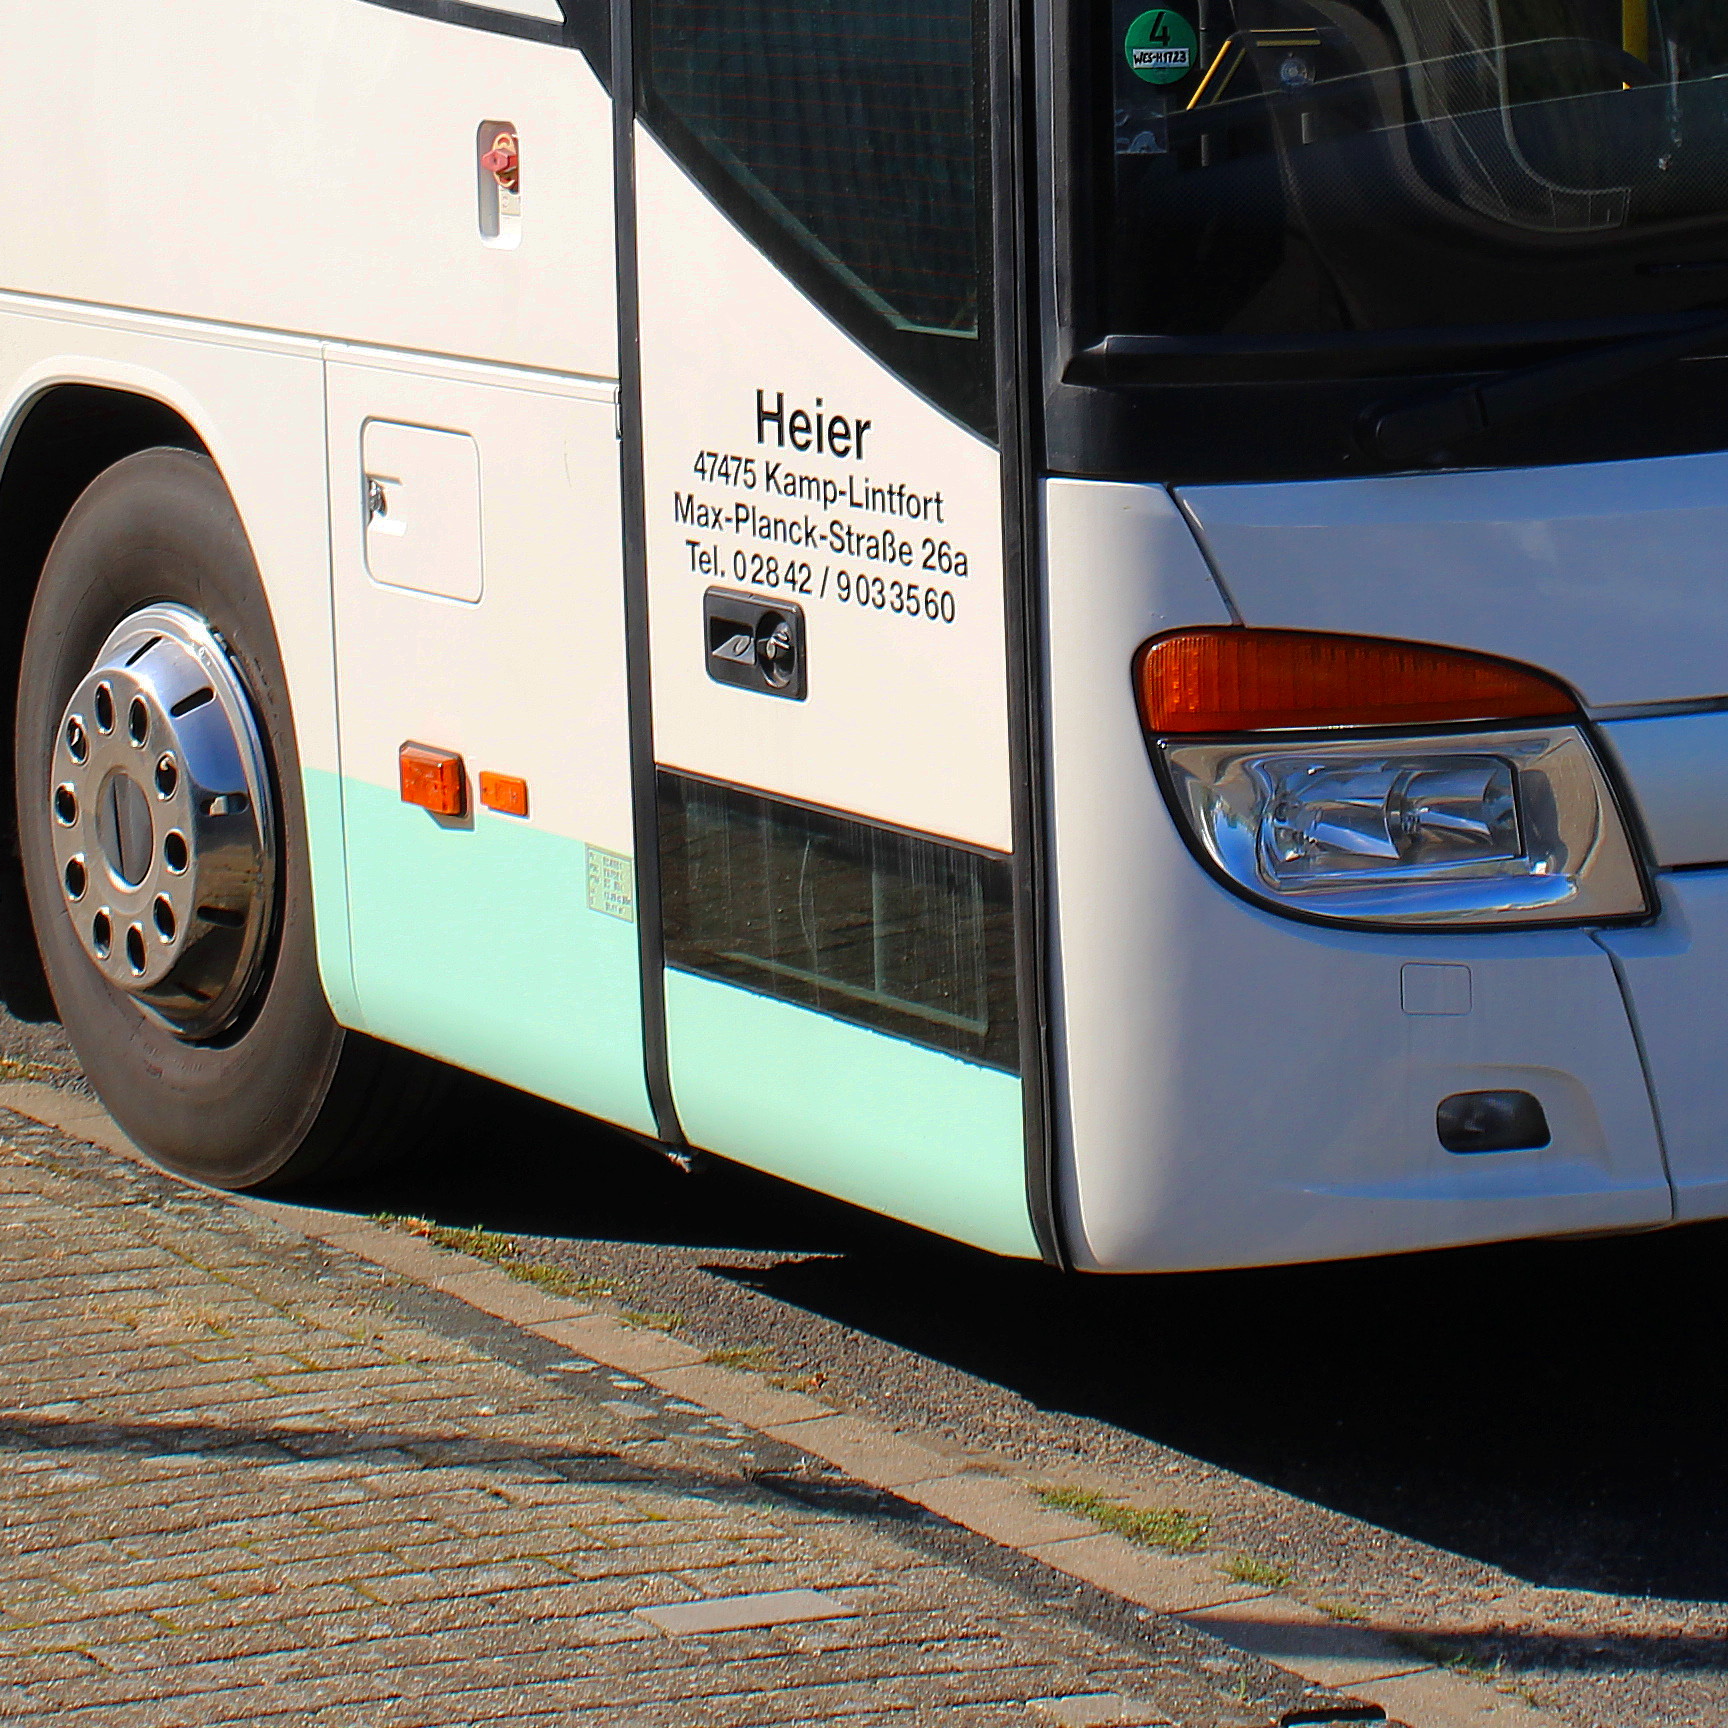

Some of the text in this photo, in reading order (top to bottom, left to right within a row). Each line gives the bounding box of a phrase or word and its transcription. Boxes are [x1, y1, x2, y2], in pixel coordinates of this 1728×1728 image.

[1149, 11, 1171, 47] 4
[756, 387, 872, 461] Heier
[693, 449, 945, 524] 47475 Kamp-Lintfort
[674, 491, 969, 579] Max-Planck-Straße 26a
[685, 539, 726, 579] Tel.
[733, 549, 812, 596] 02842
[837, 570, 956, 625] 9033560
